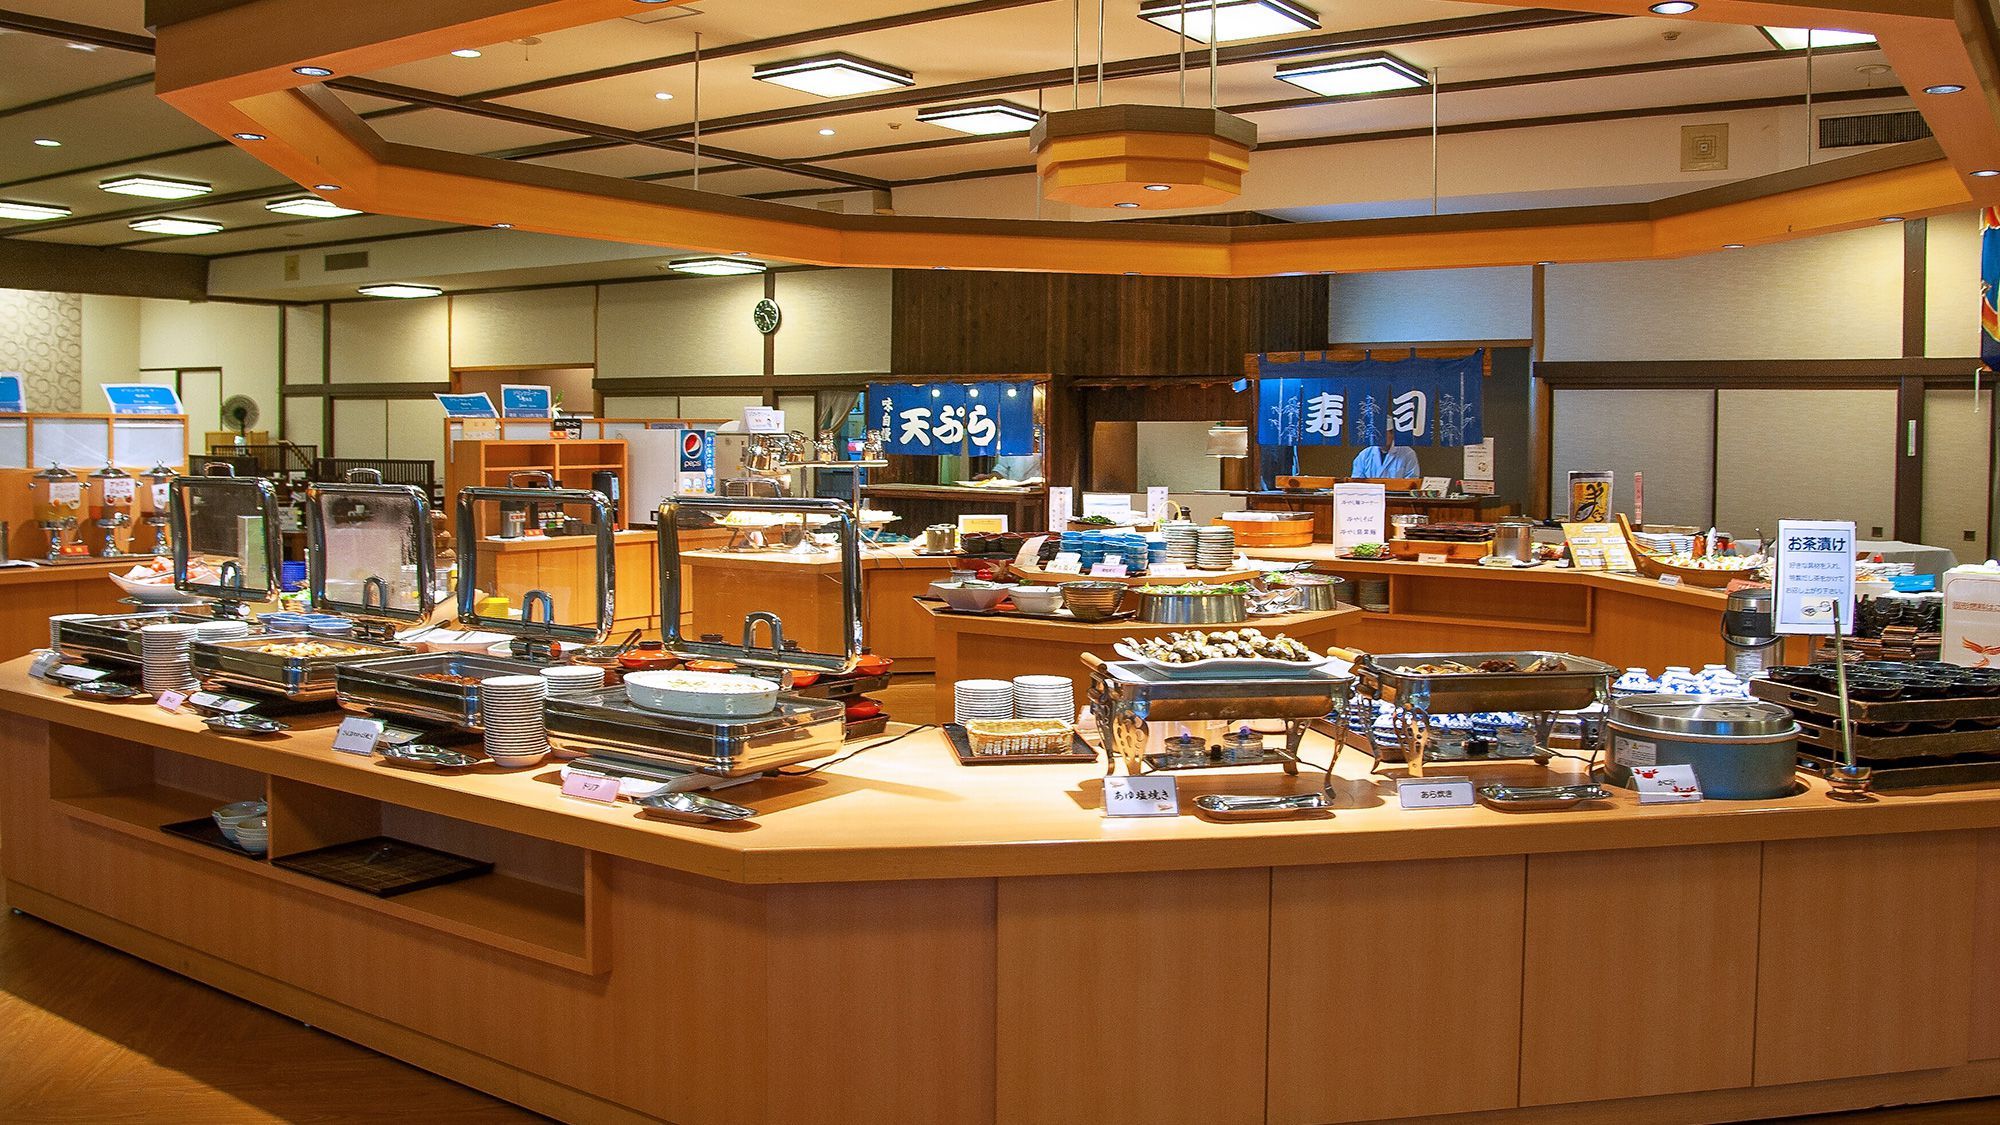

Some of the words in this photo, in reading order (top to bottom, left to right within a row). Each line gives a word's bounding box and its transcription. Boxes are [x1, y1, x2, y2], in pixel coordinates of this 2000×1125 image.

[1306, 392, 1427, 437] 寿司
[900, 404, 997, 447] 天ぷら
[1788, 536, 1847, 552] お茶漬け
[1113, 788, 1169, 801] あゆ塩焼き
[1420, 789, 1453, 800] あら炊き
